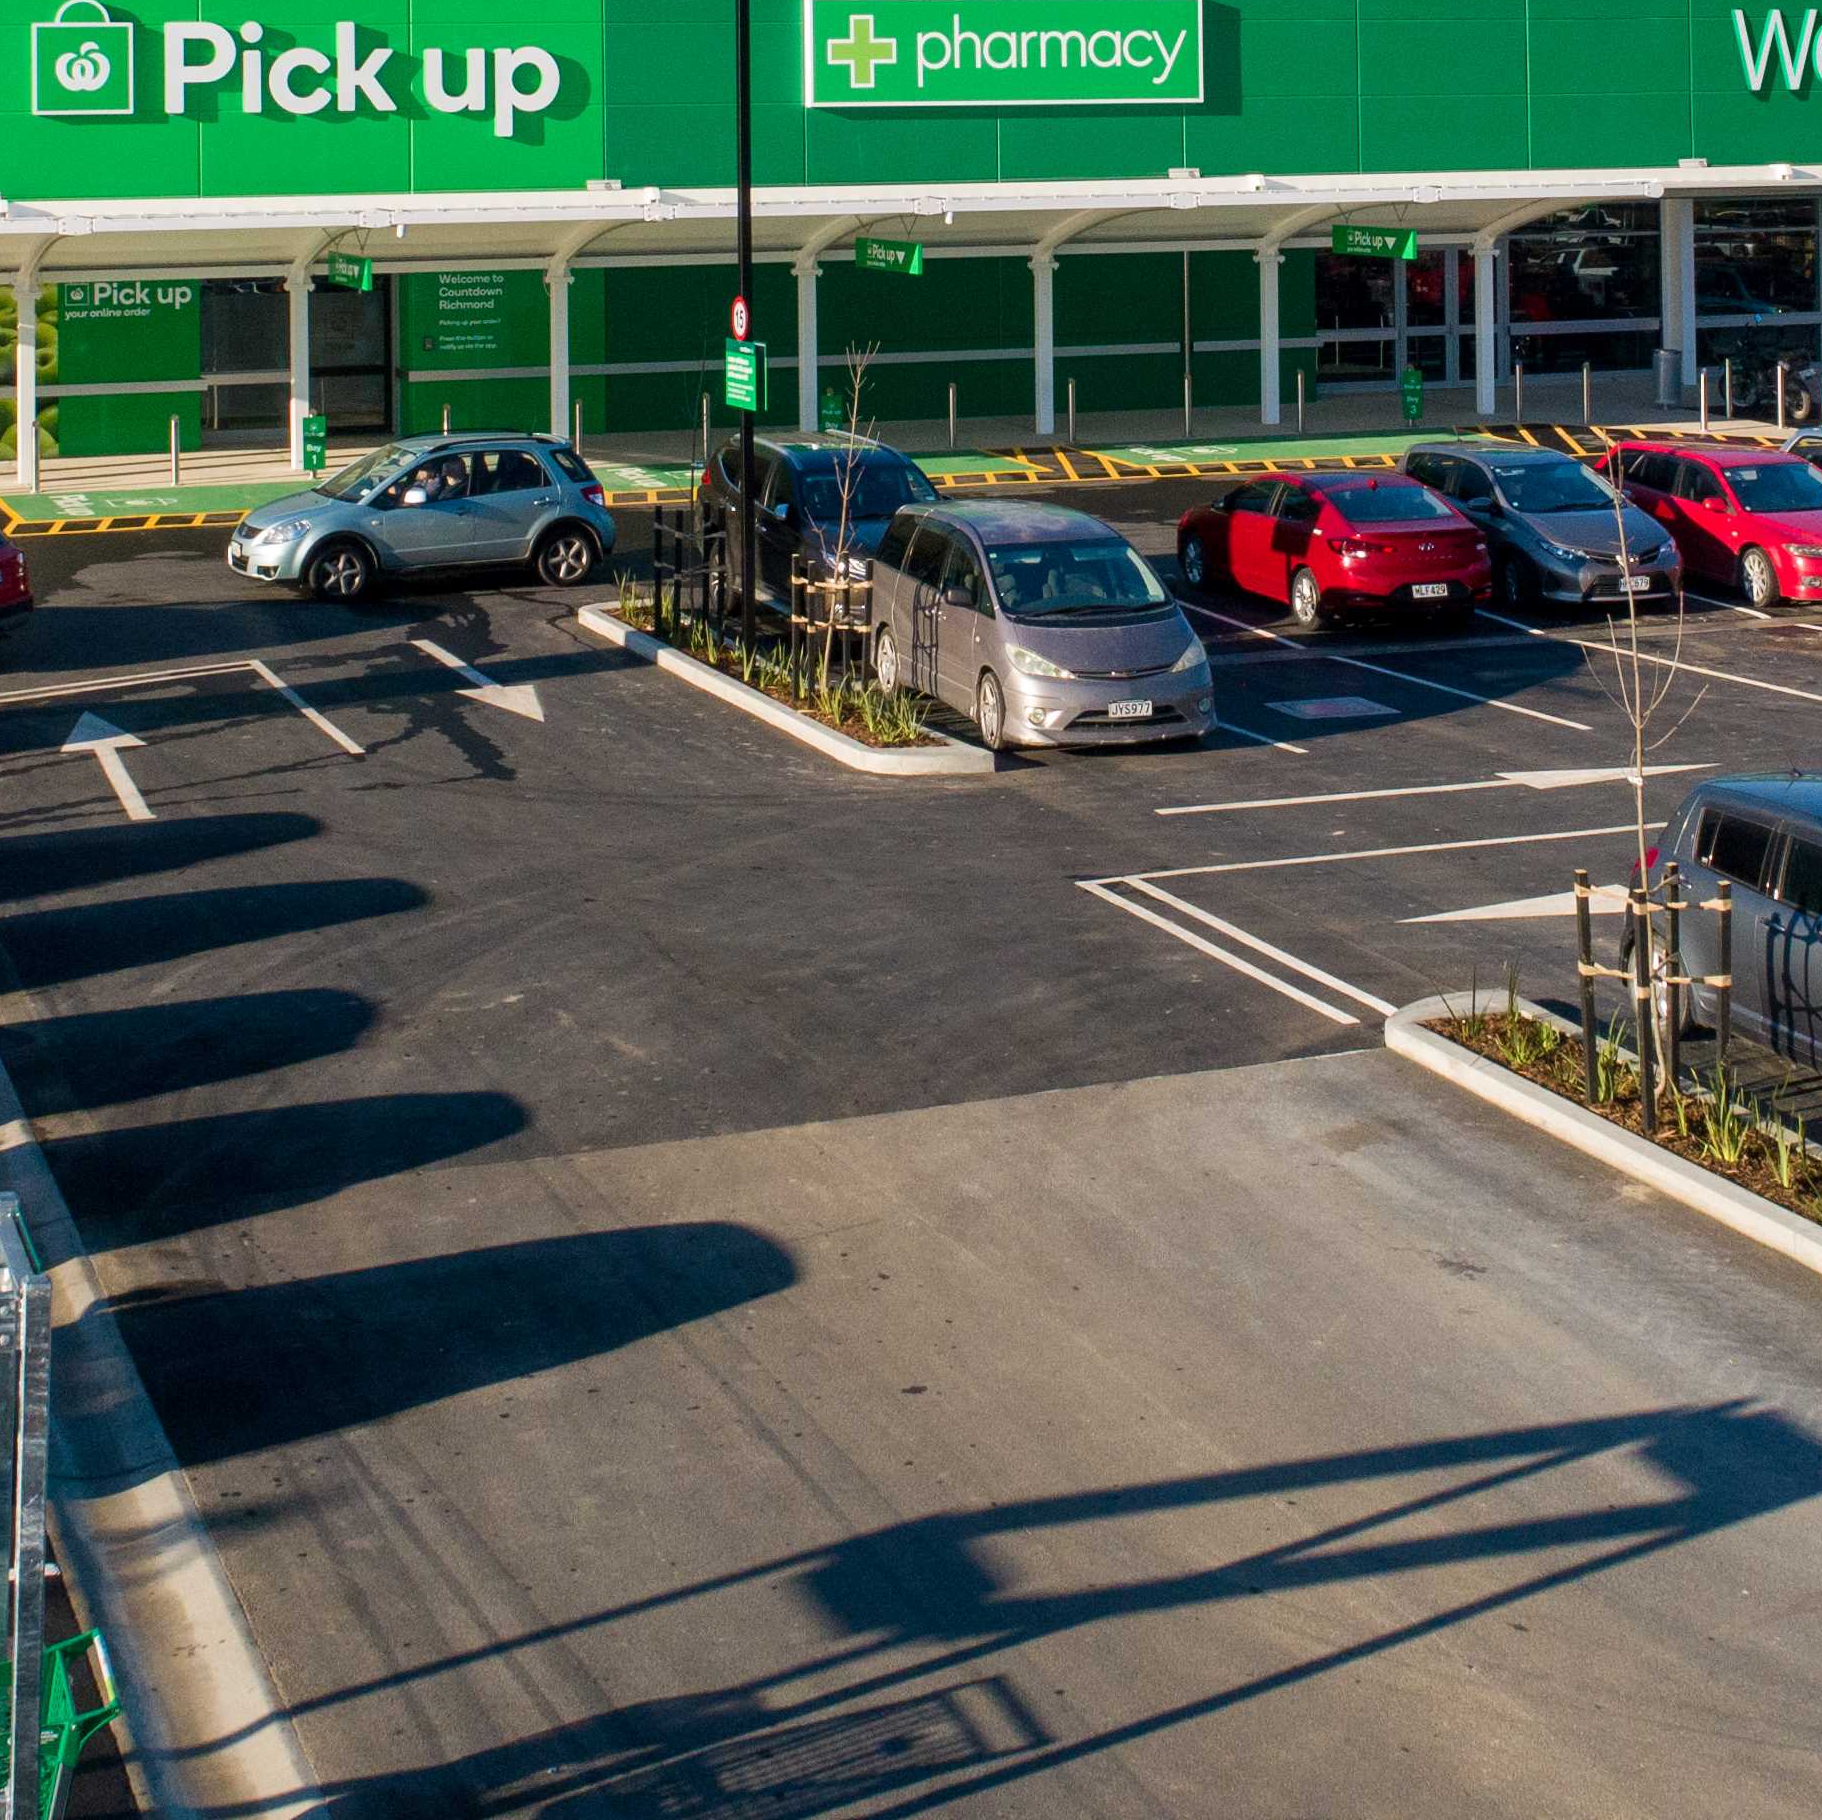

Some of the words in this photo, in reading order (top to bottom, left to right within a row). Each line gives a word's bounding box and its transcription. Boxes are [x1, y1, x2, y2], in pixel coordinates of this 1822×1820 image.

[916, 14, 1187, 88] pharmacy
[163, 20, 398, 115] Pick
[422, 45, 561, 138] up
[439, 273, 490, 284] Welcome
[492, 274, 505, 283] to
[92, 282, 150, 306] Pick
[157, 285, 192, 309] up
[439, 286, 504, 297] Countdown
[439, 299, 495, 310] Richmond
[65, 310, 89, 321] your
[90, 308, 122, 318] online
[124, 308, 151, 317] order
[1410, 404, 1417, 414] 3
[1111, 702, 1150, 715] JYS977
